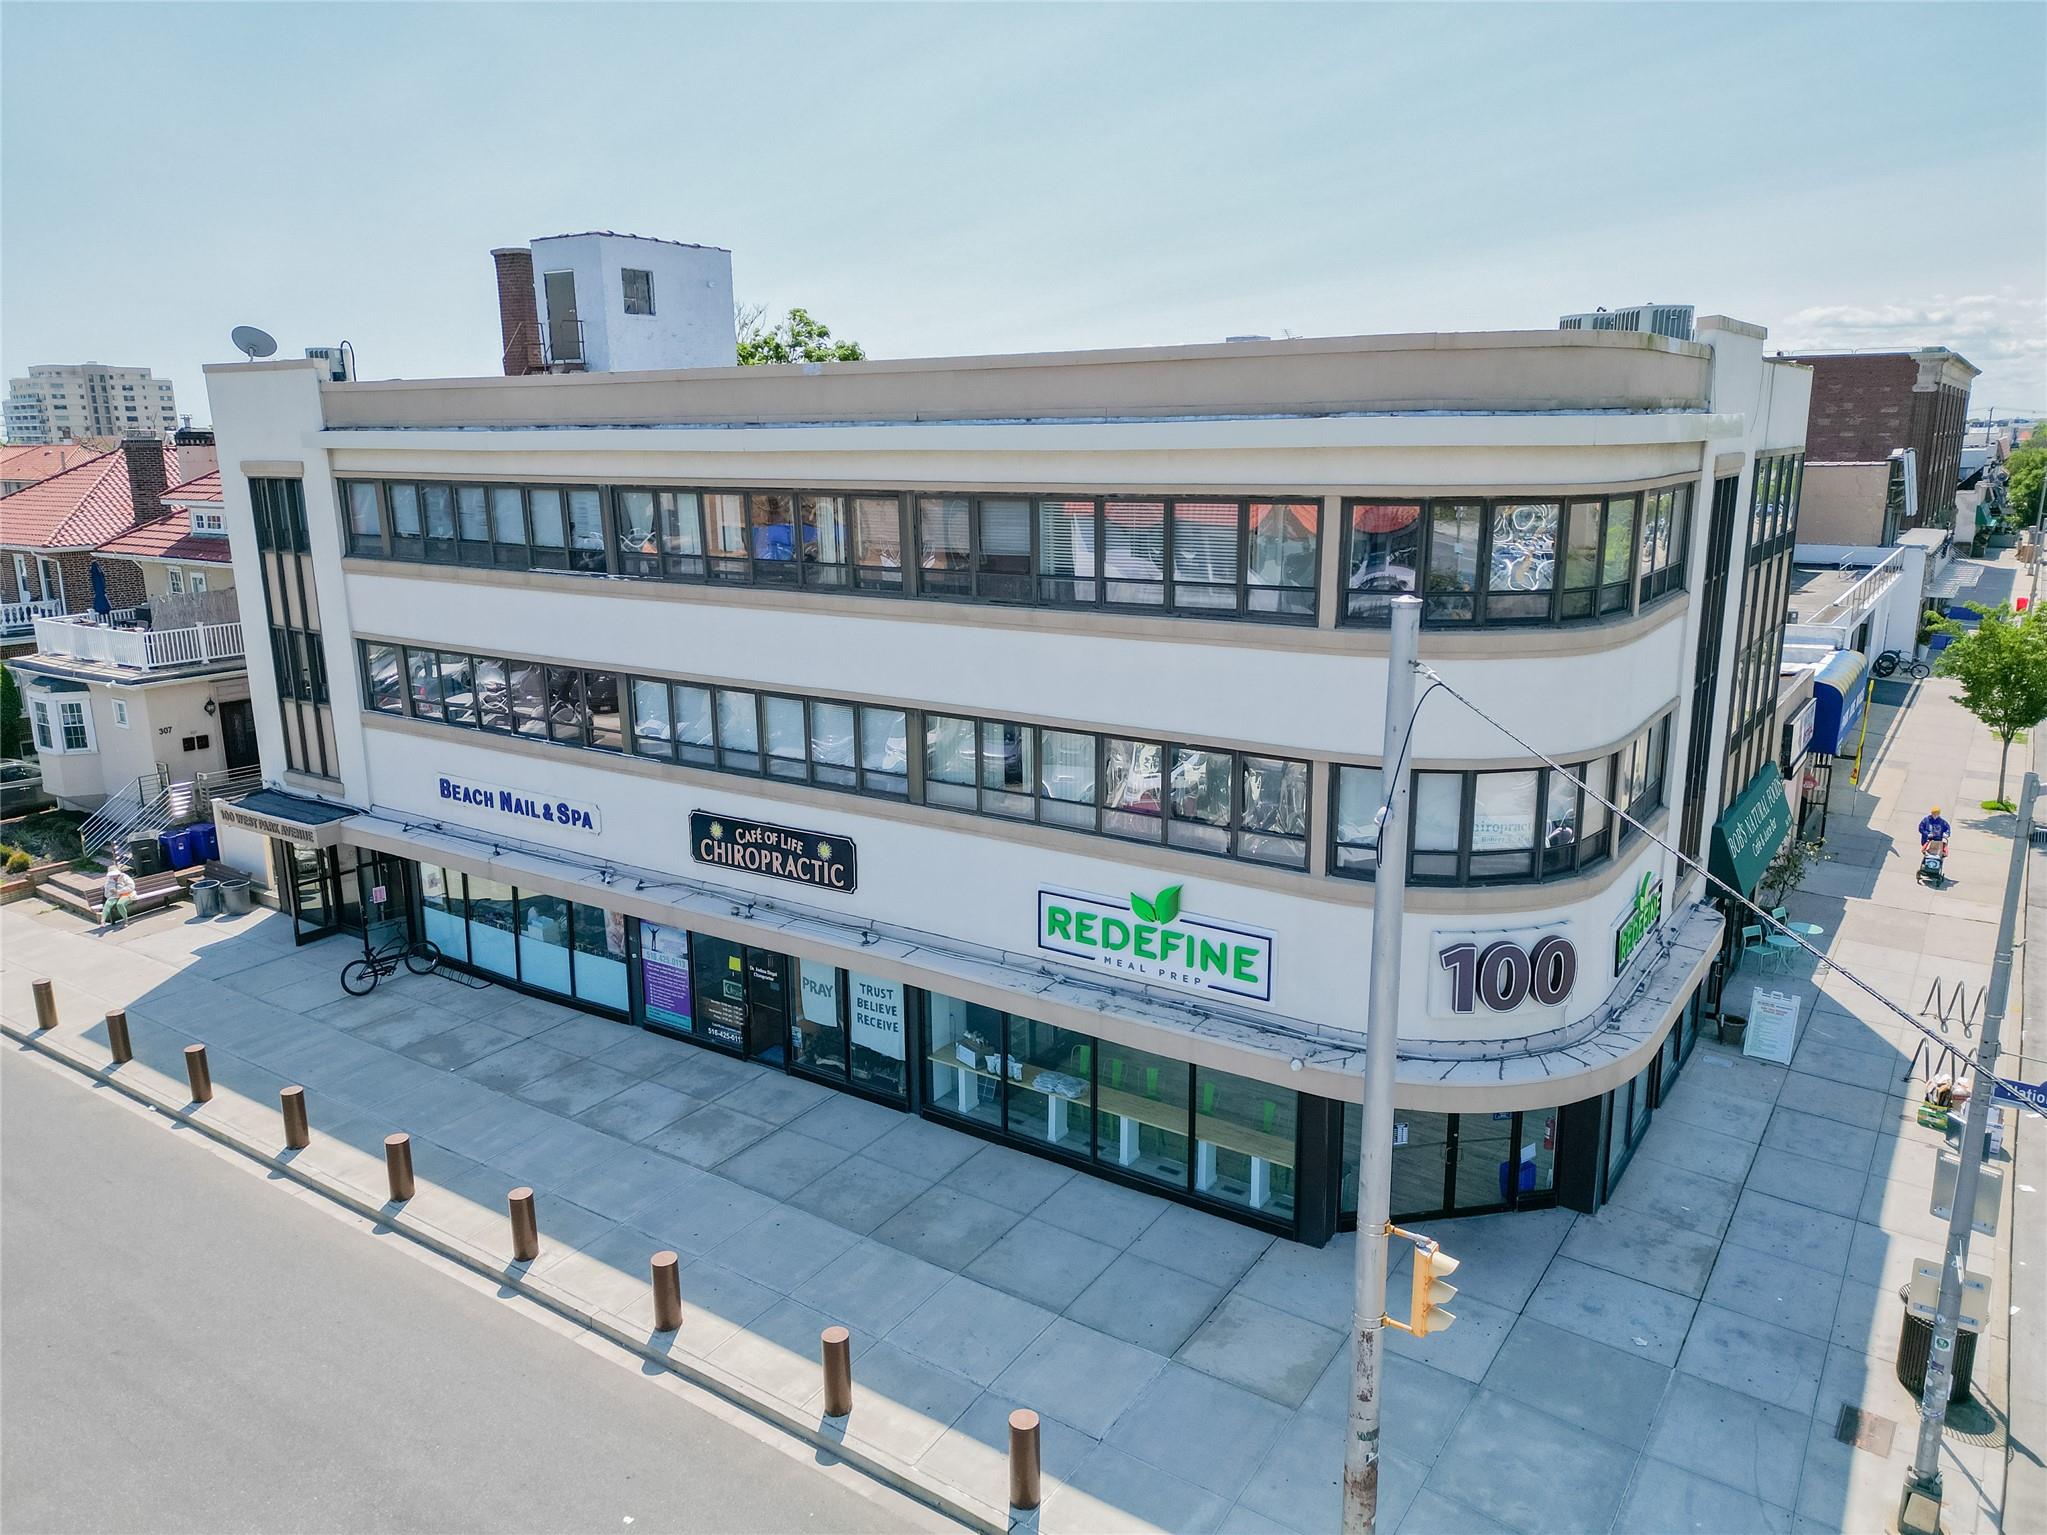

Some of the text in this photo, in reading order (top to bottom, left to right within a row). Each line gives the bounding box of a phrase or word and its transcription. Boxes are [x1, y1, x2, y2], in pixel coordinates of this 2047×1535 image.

[158, 726, 173, 736] 307
[439, 778, 593, 830] BEACH NAIL & SPA
[220, 808, 315, 842] 100 WEST PARK AVENUE
[1728, 822, 1748, 859] BOB'S
[1744, 795, 1770, 838] NATURAL
[735, 827, 804, 855] CAFÉ OF LIFE
[700, 838, 845, 887] CHIROPRACTIC
[1619, 892, 1662, 964] REDEFINE
[1047, 905, 1260, 983] REDEFINE
[1103, 956, 1201, 985] MEAL PREP
[1439, 934, 1578, 1015] 100
[802, 976, 834, 998] PRAY
[859, 982, 894, 1000] TRUST
[857, 997, 898, 1017] BELIEVE
[857, 1012, 899, 1033] RECEIVE
